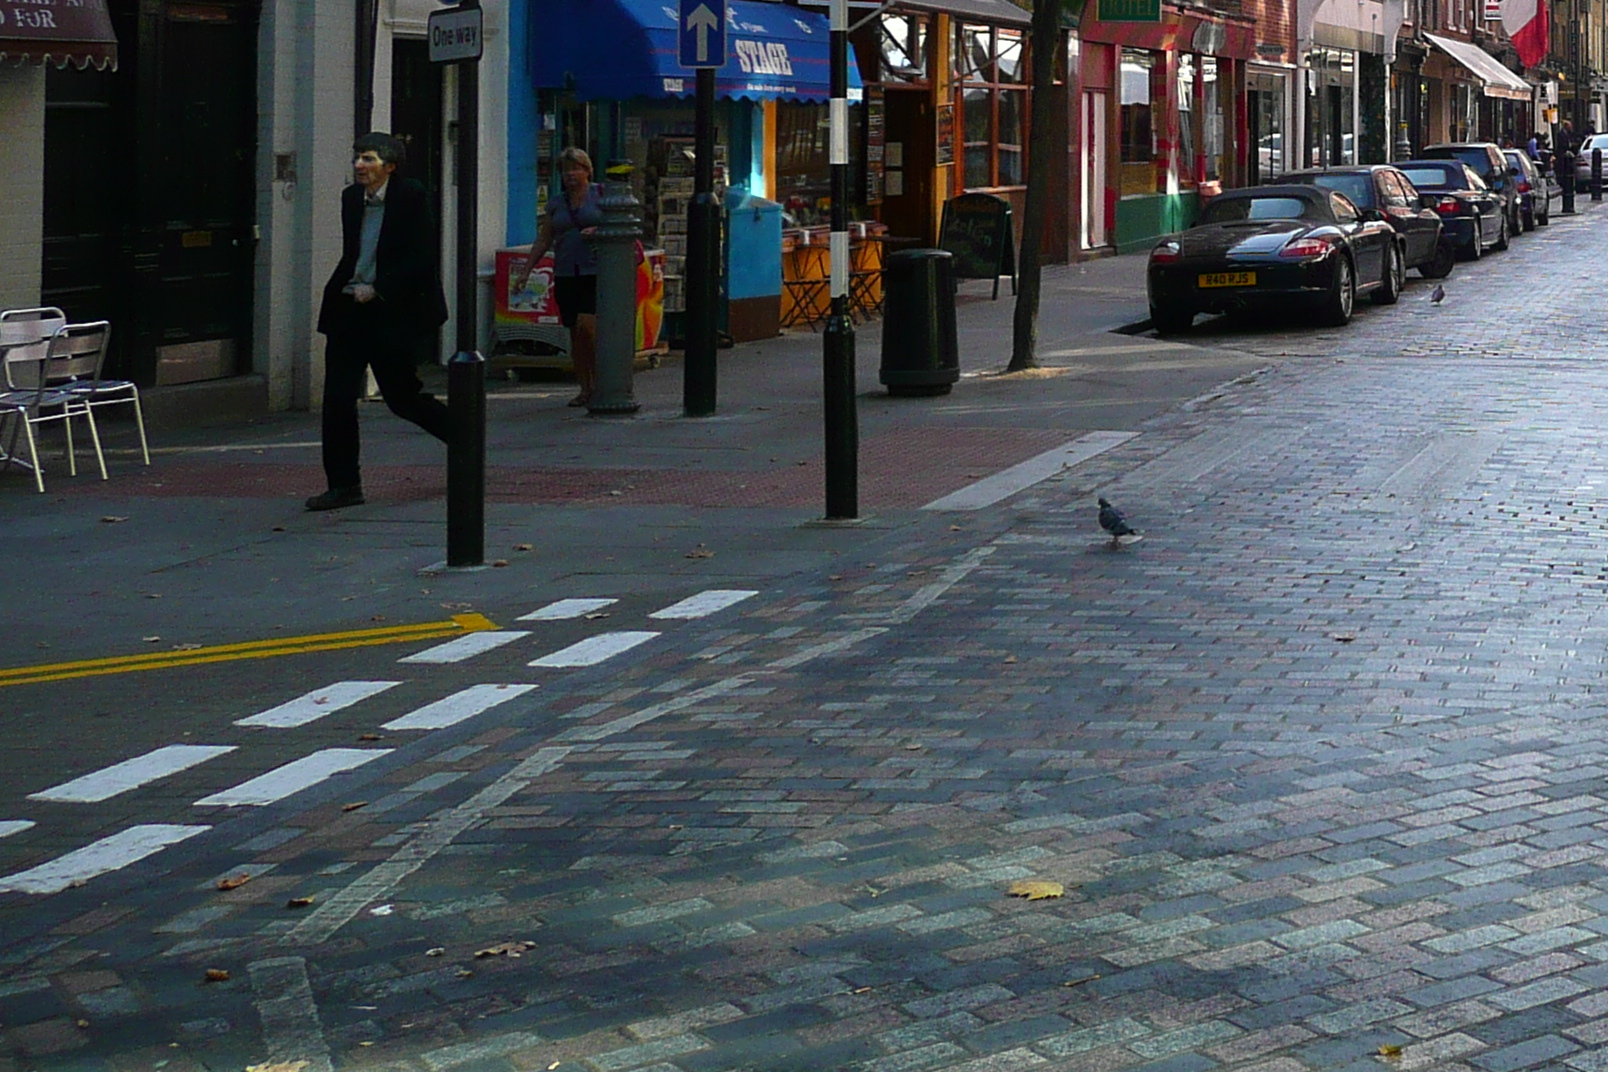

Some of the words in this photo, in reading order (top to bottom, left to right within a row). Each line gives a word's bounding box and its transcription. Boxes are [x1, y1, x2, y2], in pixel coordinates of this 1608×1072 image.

[432, 25, 453, 47] One
[455, 25, 477, 47] way
[734, 39, 793, 76] STAGE
[663, 78, 684, 92] STAGE
[1228, 271, 1249, 284] RJS
